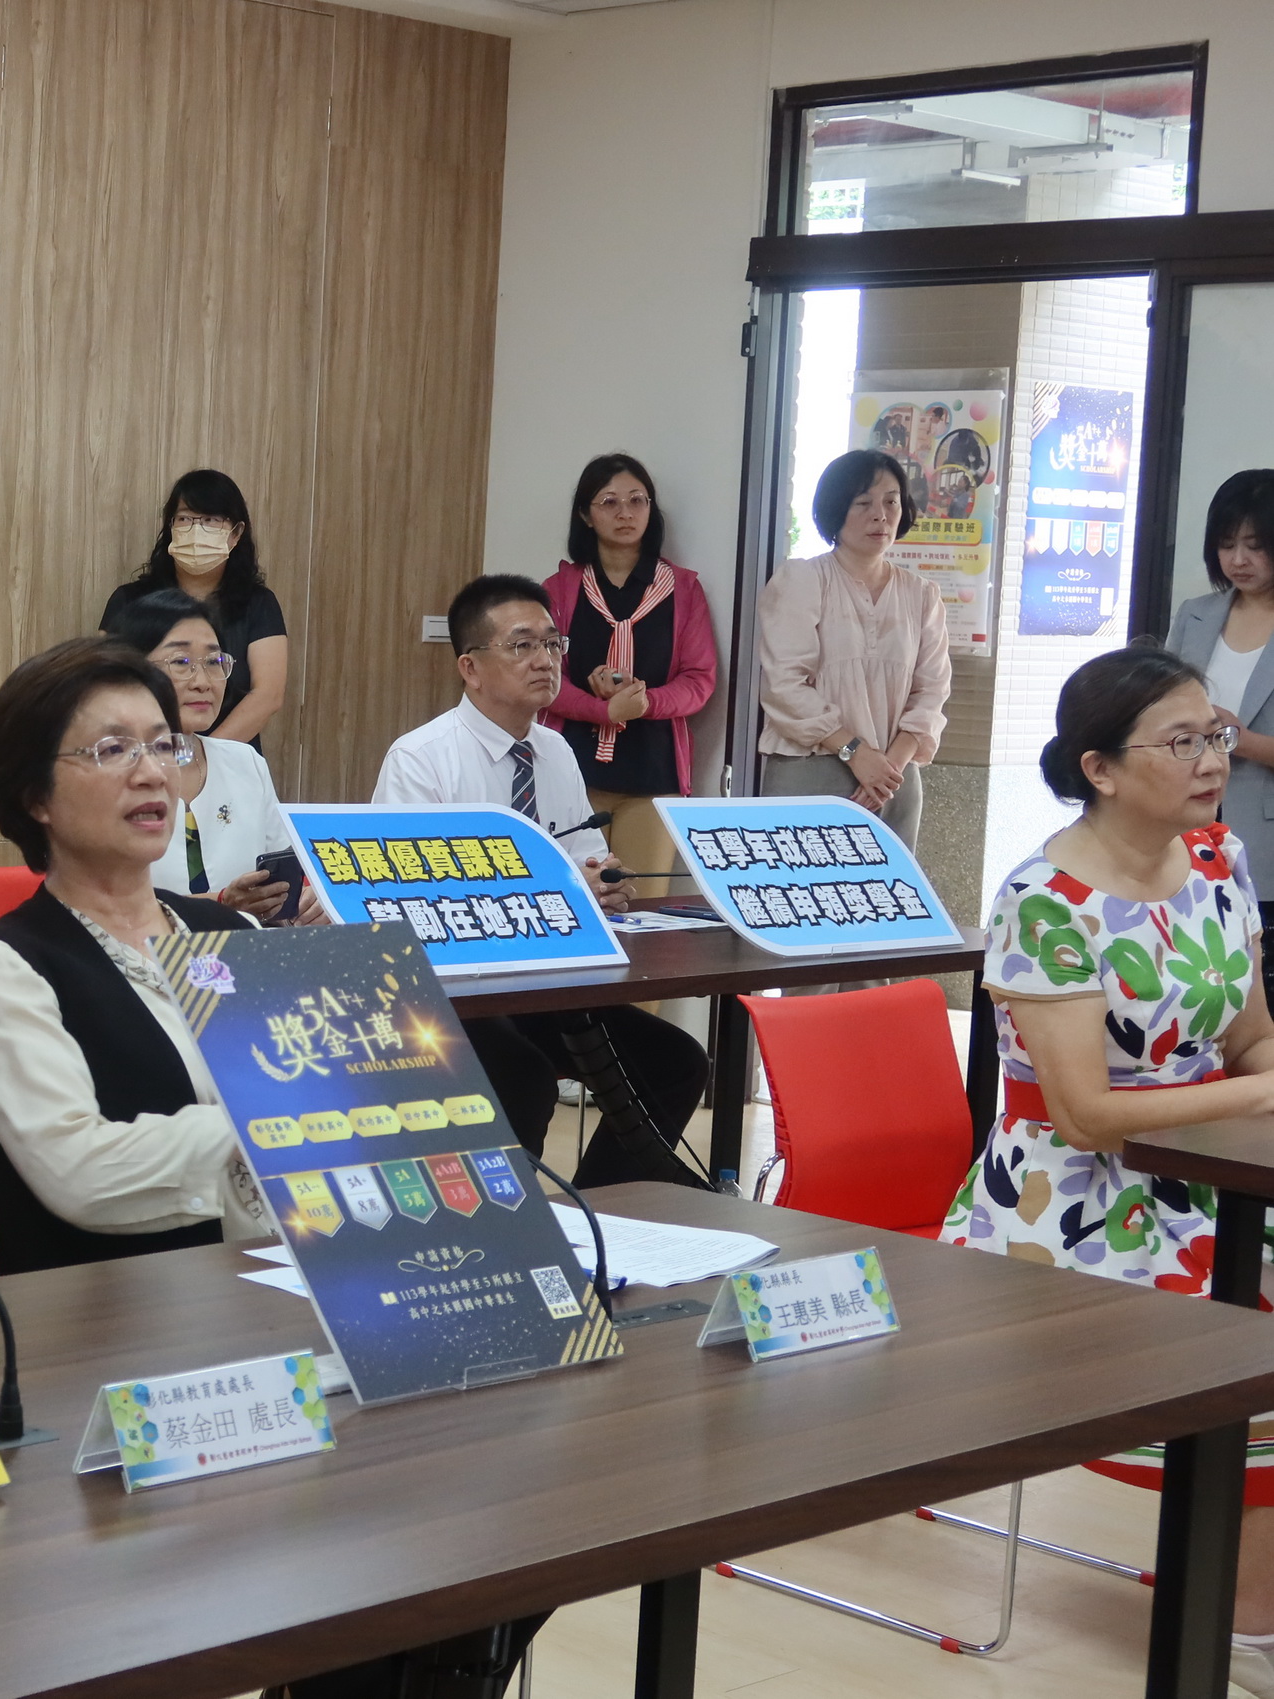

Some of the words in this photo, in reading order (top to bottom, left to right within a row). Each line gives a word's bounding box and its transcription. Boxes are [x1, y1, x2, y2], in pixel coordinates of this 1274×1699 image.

[689, 824, 887, 869] 每學年成績達標
[311, 836, 531, 885] 發展優質課程
[729, 879, 930, 927] 繼續申領獎學金
[299, 987, 366, 1031] 5A++
[267, 1011, 404, 1080] 獎金十萬
[346, 1055, 437, 1075] SCHOLARSHIP
[435, 1161, 461, 1177] 4A1B
[477, 1155, 506, 1171] 3A2B
[394, 1168, 411, 1182] 5A
[449, 1186, 471, 1201] 3萬
[493, 1180, 515, 1195] 2萬
[357, 1198, 381, 1213] 8萬
[403, 1192, 426, 1208] 5萬
[306, 1203, 336, 1219] 10萬
[775, 1296, 828, 1329] 王惠美
[830, 1289, 868, 1318] 縣長
[162, 1409, 239, 1449] 蔡金田
[247, 1397, 298, 1434] 處長
